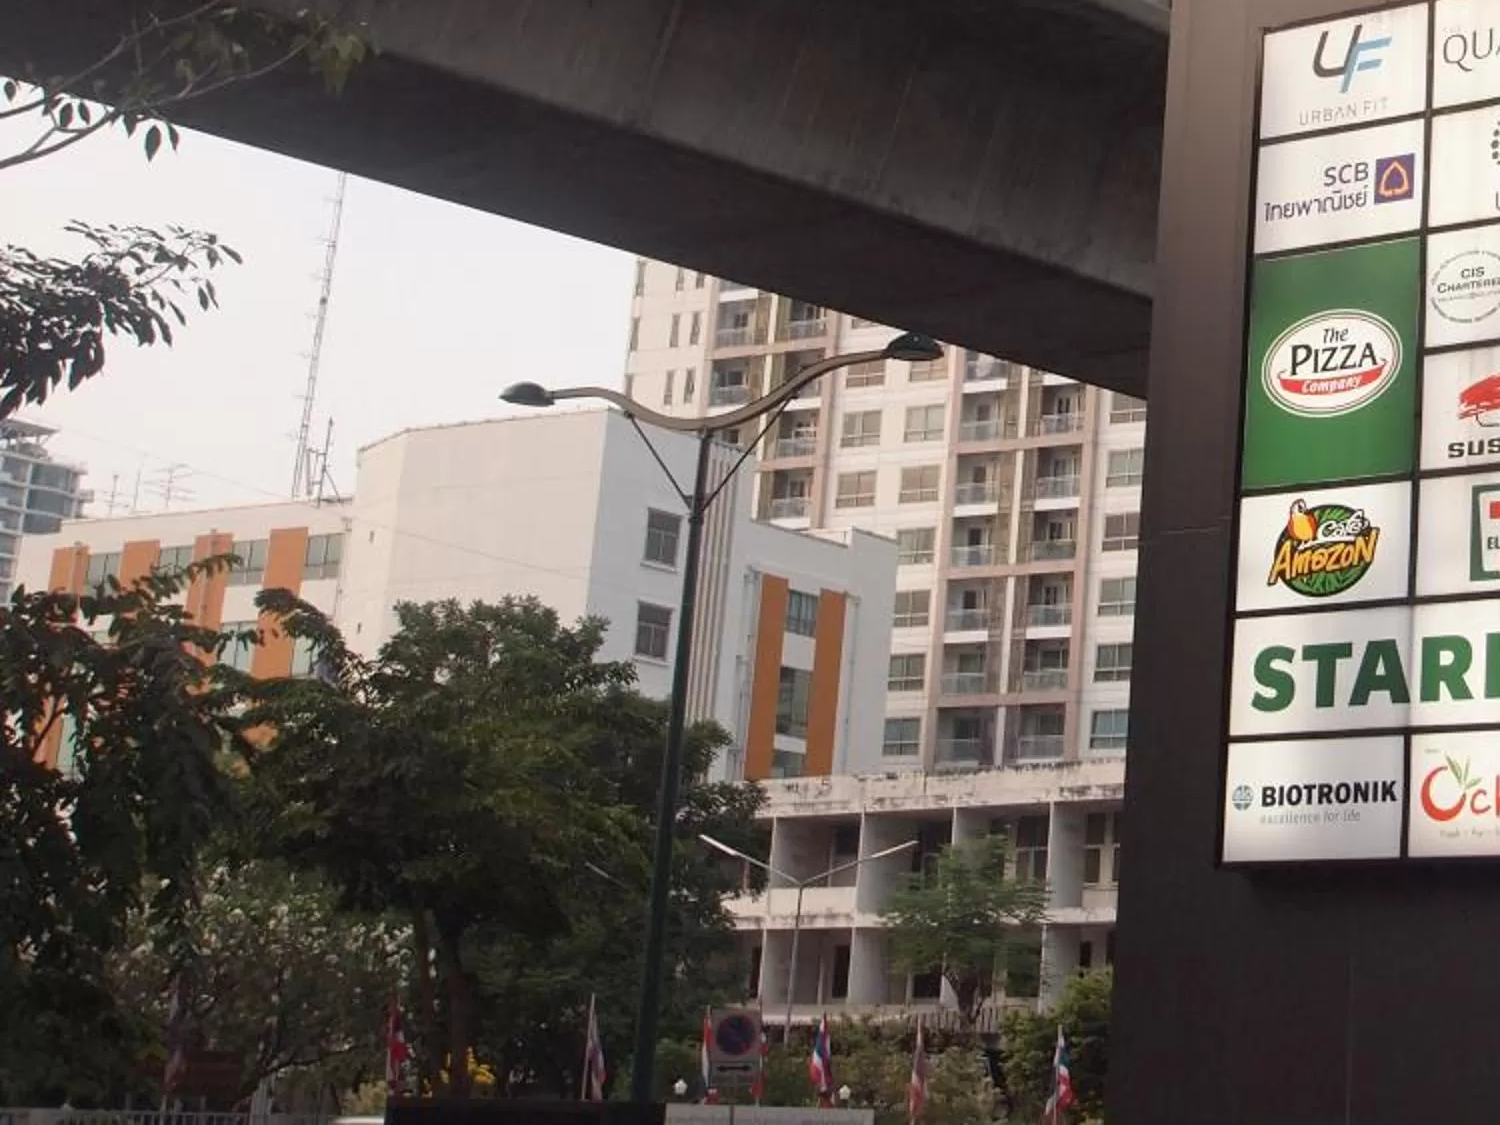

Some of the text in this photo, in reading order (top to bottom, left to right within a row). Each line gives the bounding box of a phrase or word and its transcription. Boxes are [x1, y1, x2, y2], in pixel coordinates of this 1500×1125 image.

[1298, 101, 1357, 126] URBAN
[1323, 162, 1369, 188] SCB
[1263, 185, 1369, 222] ไทยพาณิชย์
[1460, 266, 1486, 280] CIS
[1322, 326, 1350, 344] The
[1290, 342, 1378, 376] PIZZA
[1301, 375, 1363, 395] Company
[1260, 779, 1398, 808] BIOTRONIK
